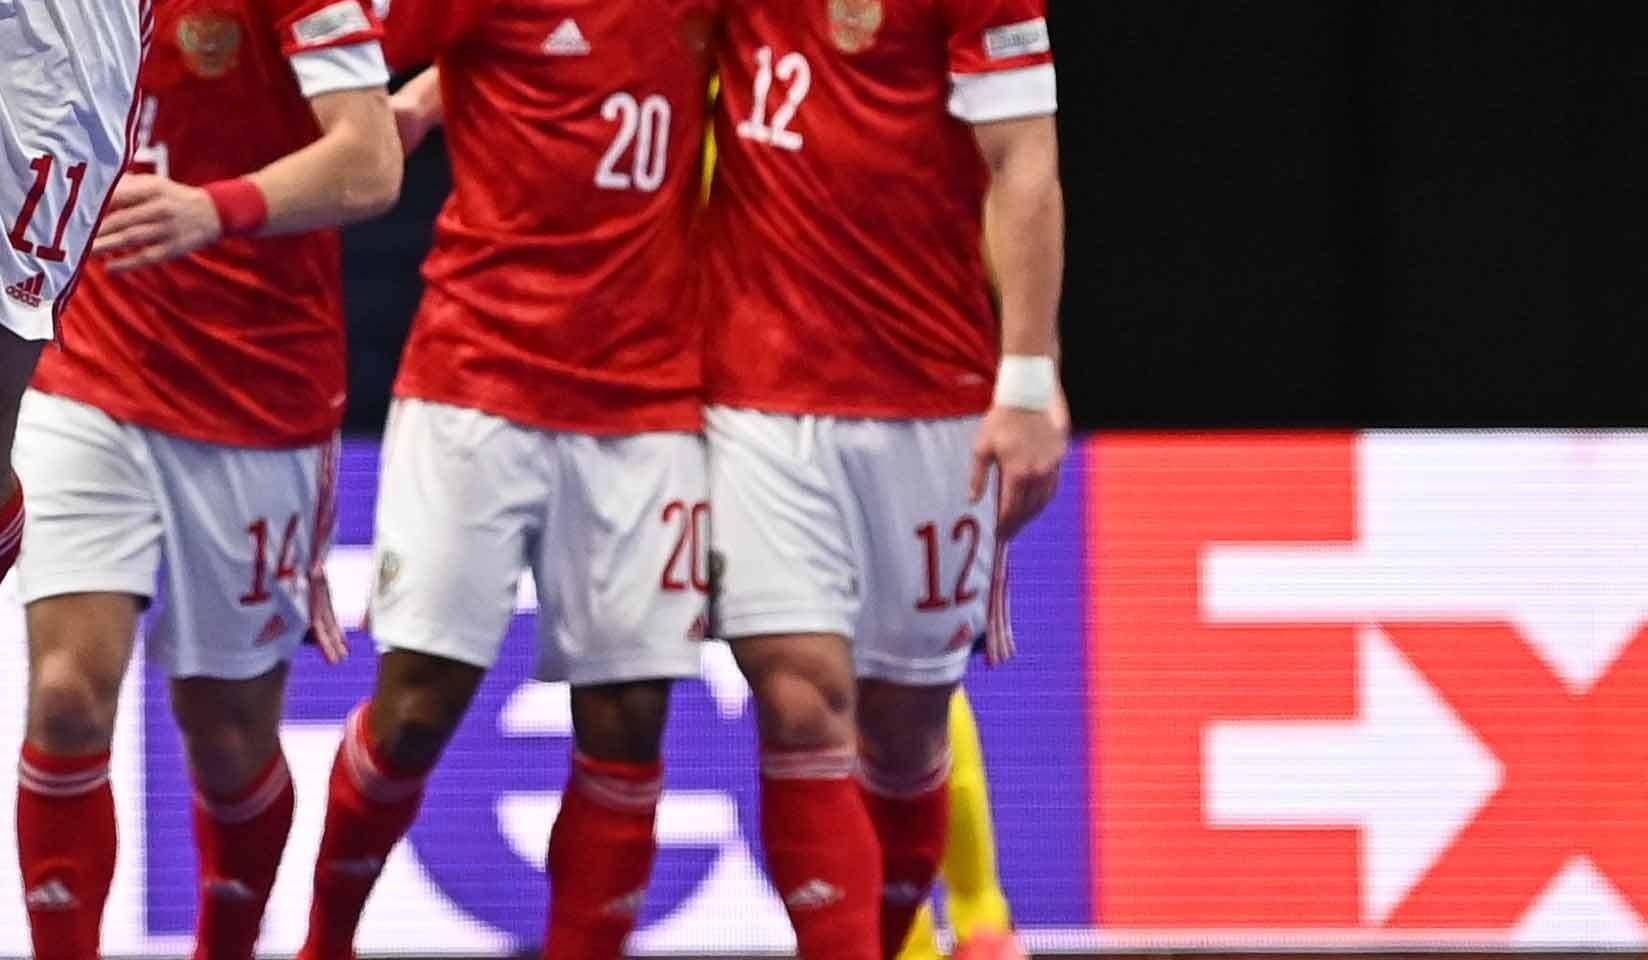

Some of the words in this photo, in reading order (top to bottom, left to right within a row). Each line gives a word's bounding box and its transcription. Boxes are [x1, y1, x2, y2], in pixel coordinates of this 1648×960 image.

[595, 92, 671, 192] 20
[736, 45, 811, 151] 12
[8, 154, 87, 262] 11
[239, 512, 299, 606] 14
[661, 500, 713, 596] 20
[914, 513, 981, 612] 12
